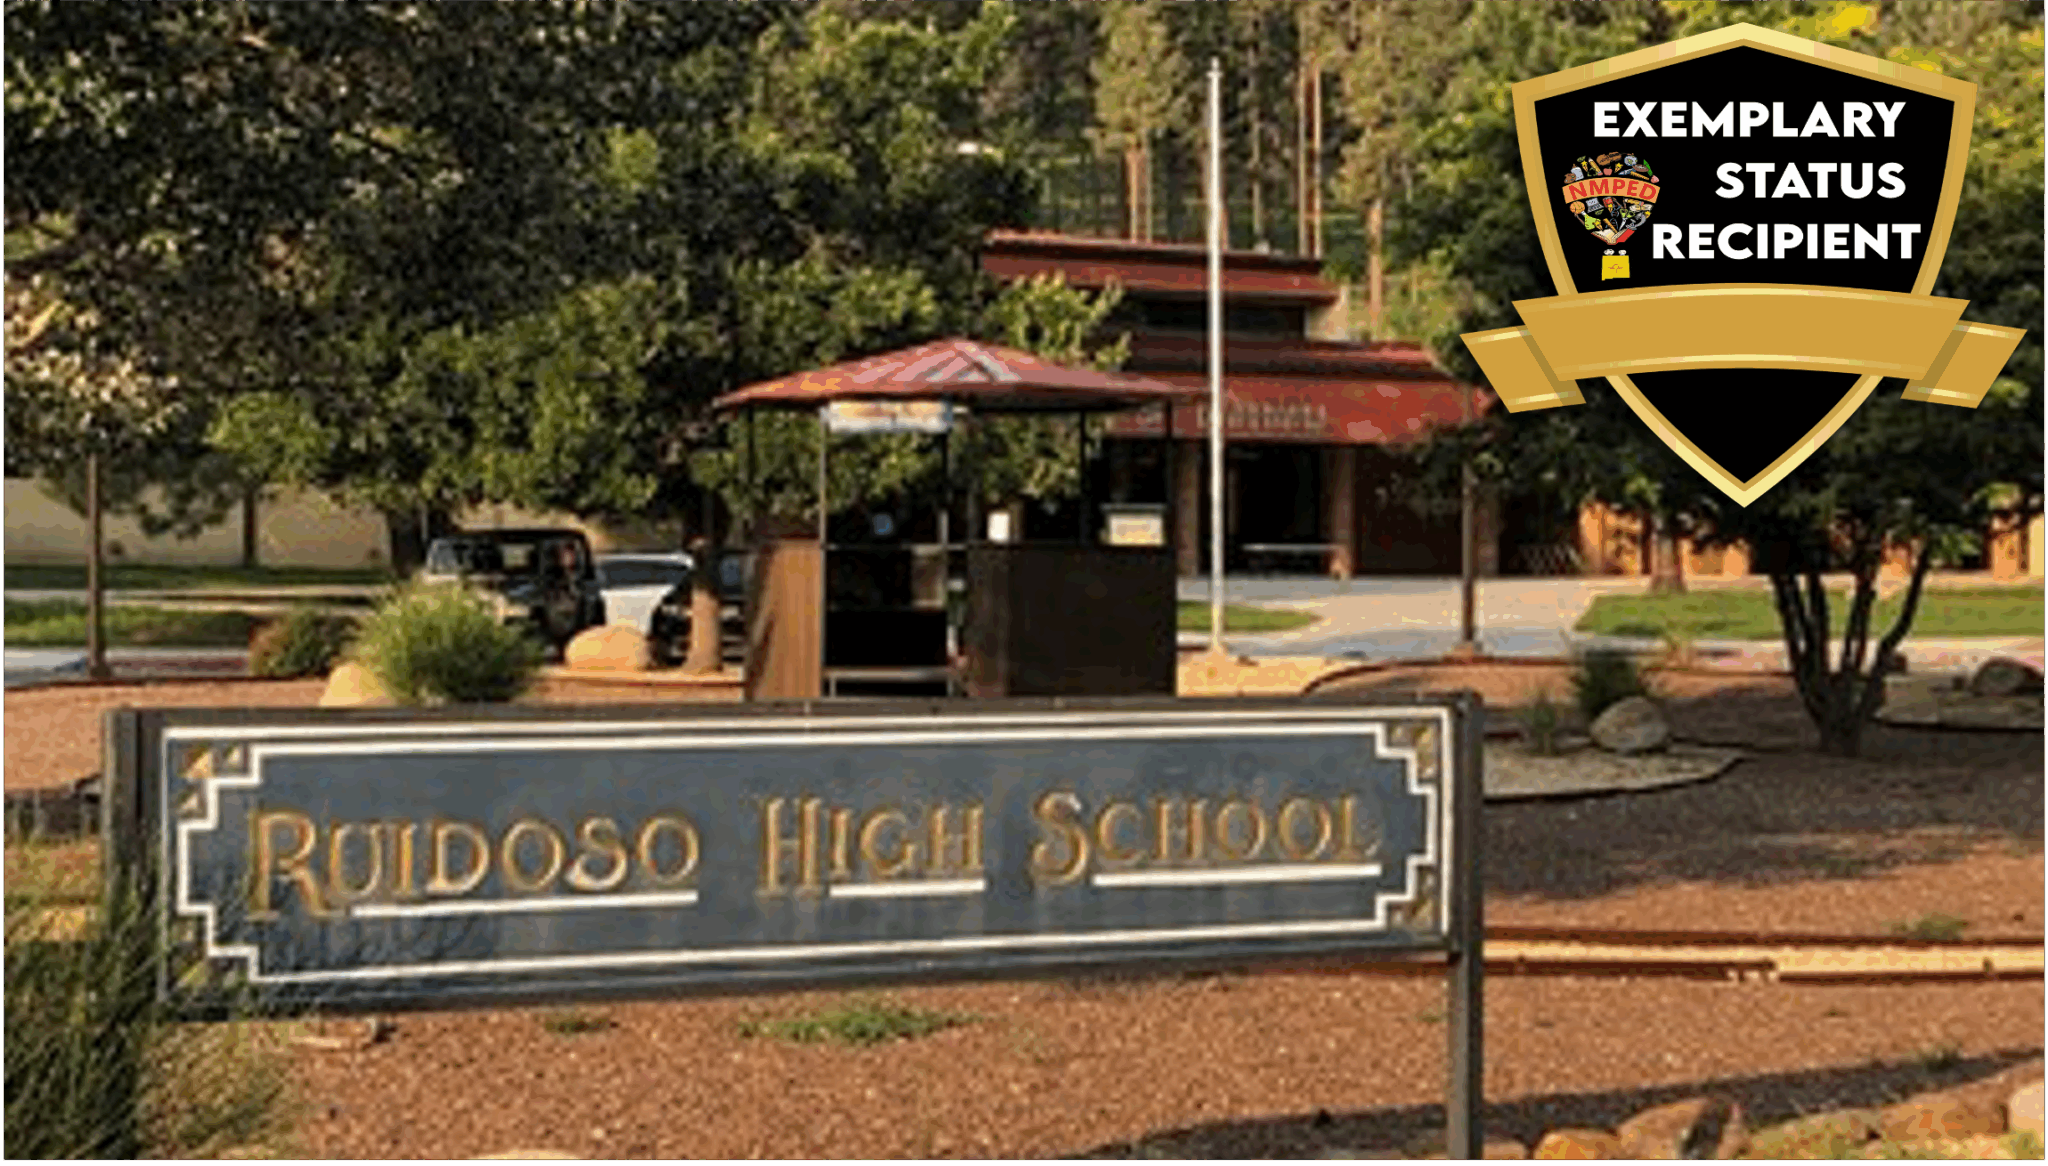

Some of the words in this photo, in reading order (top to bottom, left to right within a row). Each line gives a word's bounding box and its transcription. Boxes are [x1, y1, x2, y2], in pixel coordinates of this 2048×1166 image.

[246, 810, 700, 922] RUIDOSO
[758, 796, 985, 898] HIGH
[1032, 790, 1381, 886] SCHOOL
